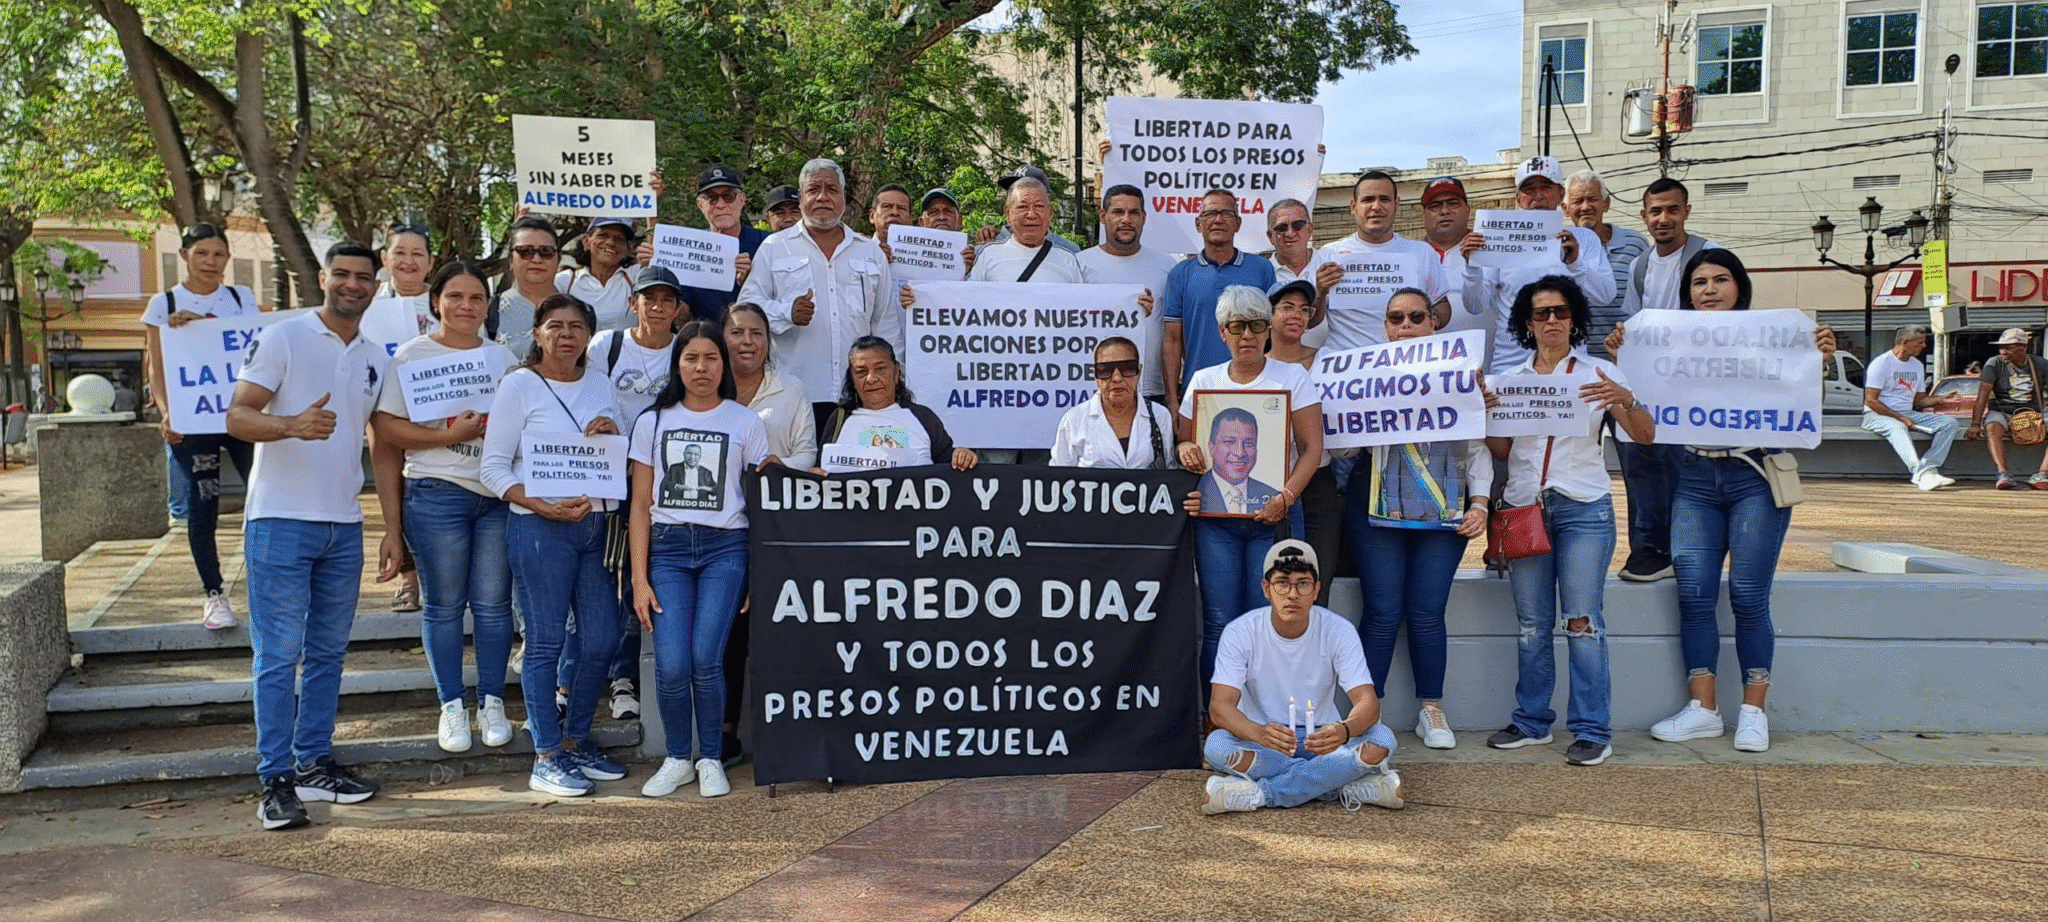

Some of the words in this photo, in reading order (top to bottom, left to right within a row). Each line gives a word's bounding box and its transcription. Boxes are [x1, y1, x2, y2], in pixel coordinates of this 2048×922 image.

[578, 126, 590, 142] 5
[1134, 119, 1231, 139] LIBERTAD
[1237, 122, 1292, 140] PARA
[562, 151, 614, 166] MESES
[1119, 144, 1186, 163] TODOS
[1192, 146, 1227, 164] LOS
[1233, 148, 1305, 166] PRESOS
[529, 171, 555, 186] SIN
[561, 173, 615, 188] SABER
[621, 174, 643, 188] DE
[1144, 168, 1246, 189] POLÍTICOS
[1250, 173, 1277, 190] EN
[524, 191, 606, 209] ALFREDO
[611, 195, 653, 209] DIAZ
[1152, 196, 1265, 214] VENELA
[1482, 221, 1534, 229] LIBERTAD
[663, 236, 713, 250] LIBERTAD
[898, 235, 944, 248] LIBERTAD
[688, 252, 724, 265] PRESOS
[922, 250, 954, 260] PRESOS
[1971, 268, 2048, 302] LID
[912, 308, 1027, 327] ELEVAMOS
[1034, 309, 1139, 328] NUESTRAS
[920, 334, 1047, 354] ORACIONES
[1053, 336, 1098, 354] POR
[1321, 354, 1352, 374] TU
[1359, 337, 1468, 370] FAMILIA
[179, 365, 217, 386] LA
[412, 362, 474, 380] LIBERTAD
[450, 374, 492, 386] PRESOS
[956, 362, 1061, 381] LIBERTAD
[1068, 363, 1095, 381] DE
[1439, 369, 1476, 394] TU
[947, 389, 1049, 408] ALFREDO
[1055, 389, 1098, 408] DIA
[1496, 387, 1557, 395] LIBERTAD
[1530, 400, 1572, 408] PRESOS
[1322, 406, 1458, 436] LIBERTAD
[667, 431, 723, 442] LIBERTAD
[534, 444, 595, 455] LIBERTAD
[569, 460, 610, 469] PRESOS
[829, 455, 887, 467] LIBERTAD
[663, 499, 697, 507] ALFREDO
[760, 476, 951, 512] LIBERTAD
[973, 478, 999, 511] Y
[1018, 479, 1175, 517] JUSTICIA
[915, 526, 1022, 559] PARA
[772, 577, 1022, 623] ALFREDO
[1042, 579, 1161, 623] DIAZ
[835, 641, 861, 673] Y
[882, 638, 1007, 671] TODOS
[1030, 639, 1095, 670] LOS
[764, 686, 901, 724] PRESOS
[915, 677, 1102, 715] POLÍTICOS
[1117, 685, 1160, 712] EN
[854, 728, 1069, 762] VENEZUELA
